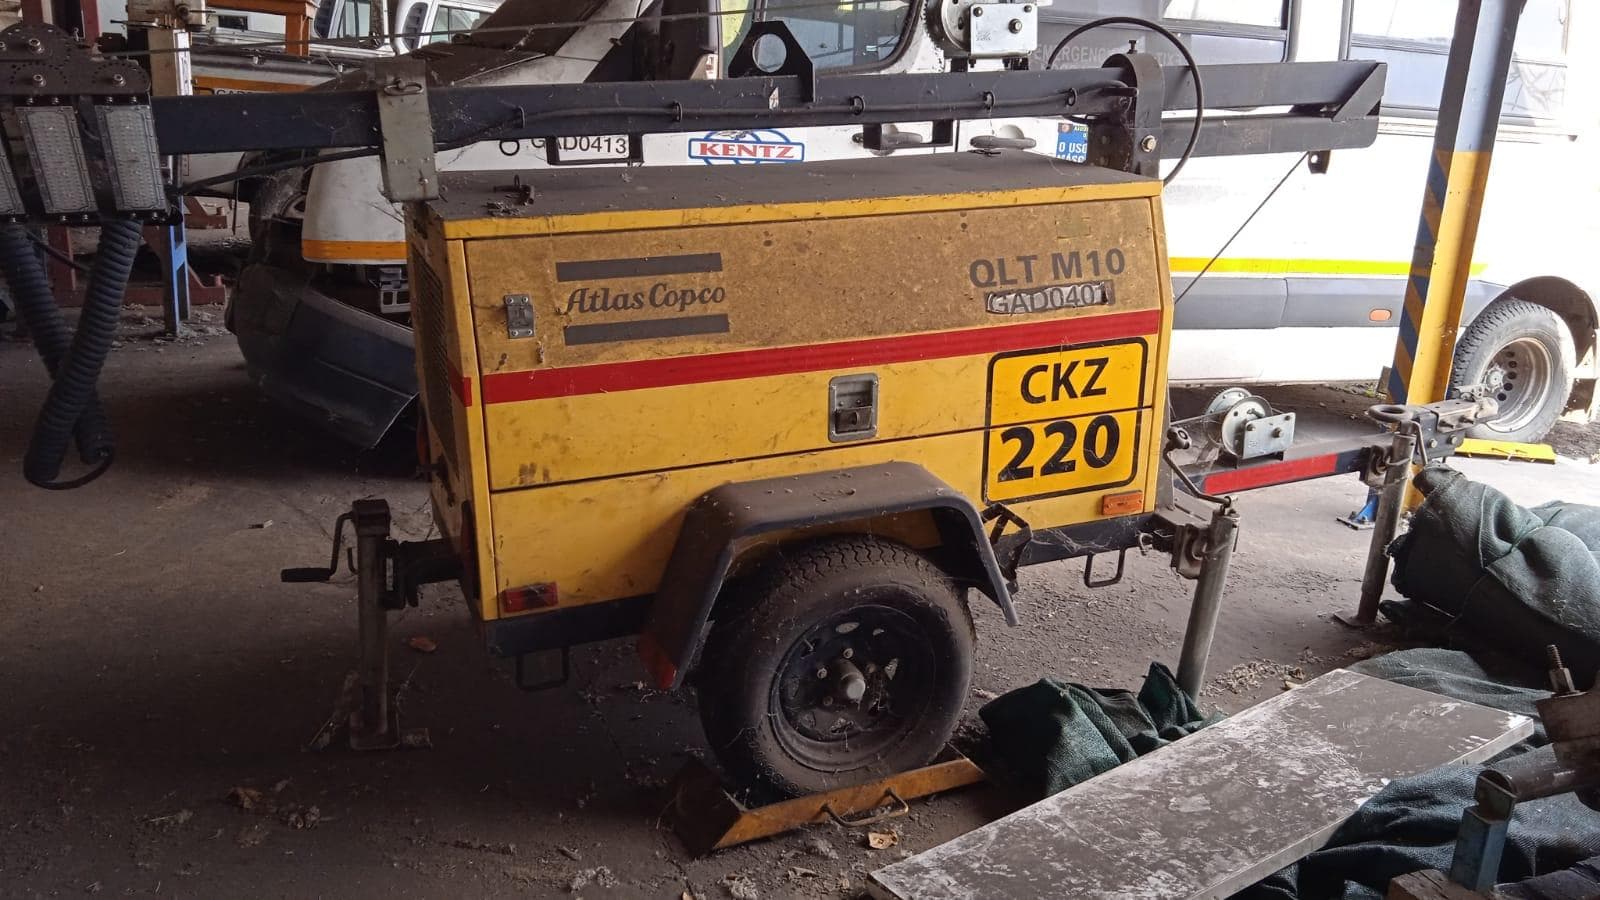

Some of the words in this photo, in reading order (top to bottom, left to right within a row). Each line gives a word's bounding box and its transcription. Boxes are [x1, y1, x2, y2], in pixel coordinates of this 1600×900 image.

[531, 136, 627, 154] GD0413
[700, 142, 795, 159] KENTZ
[969, 254, 1038, 288] QLT
[1051, 248, 1126, 281] M10
[564, 287, 645, 315] Atlas
[648, 282, 726, 313] Copco
[1020, 357, 1110, 405] CKZ
[997, 414, 1121, 483] 220
